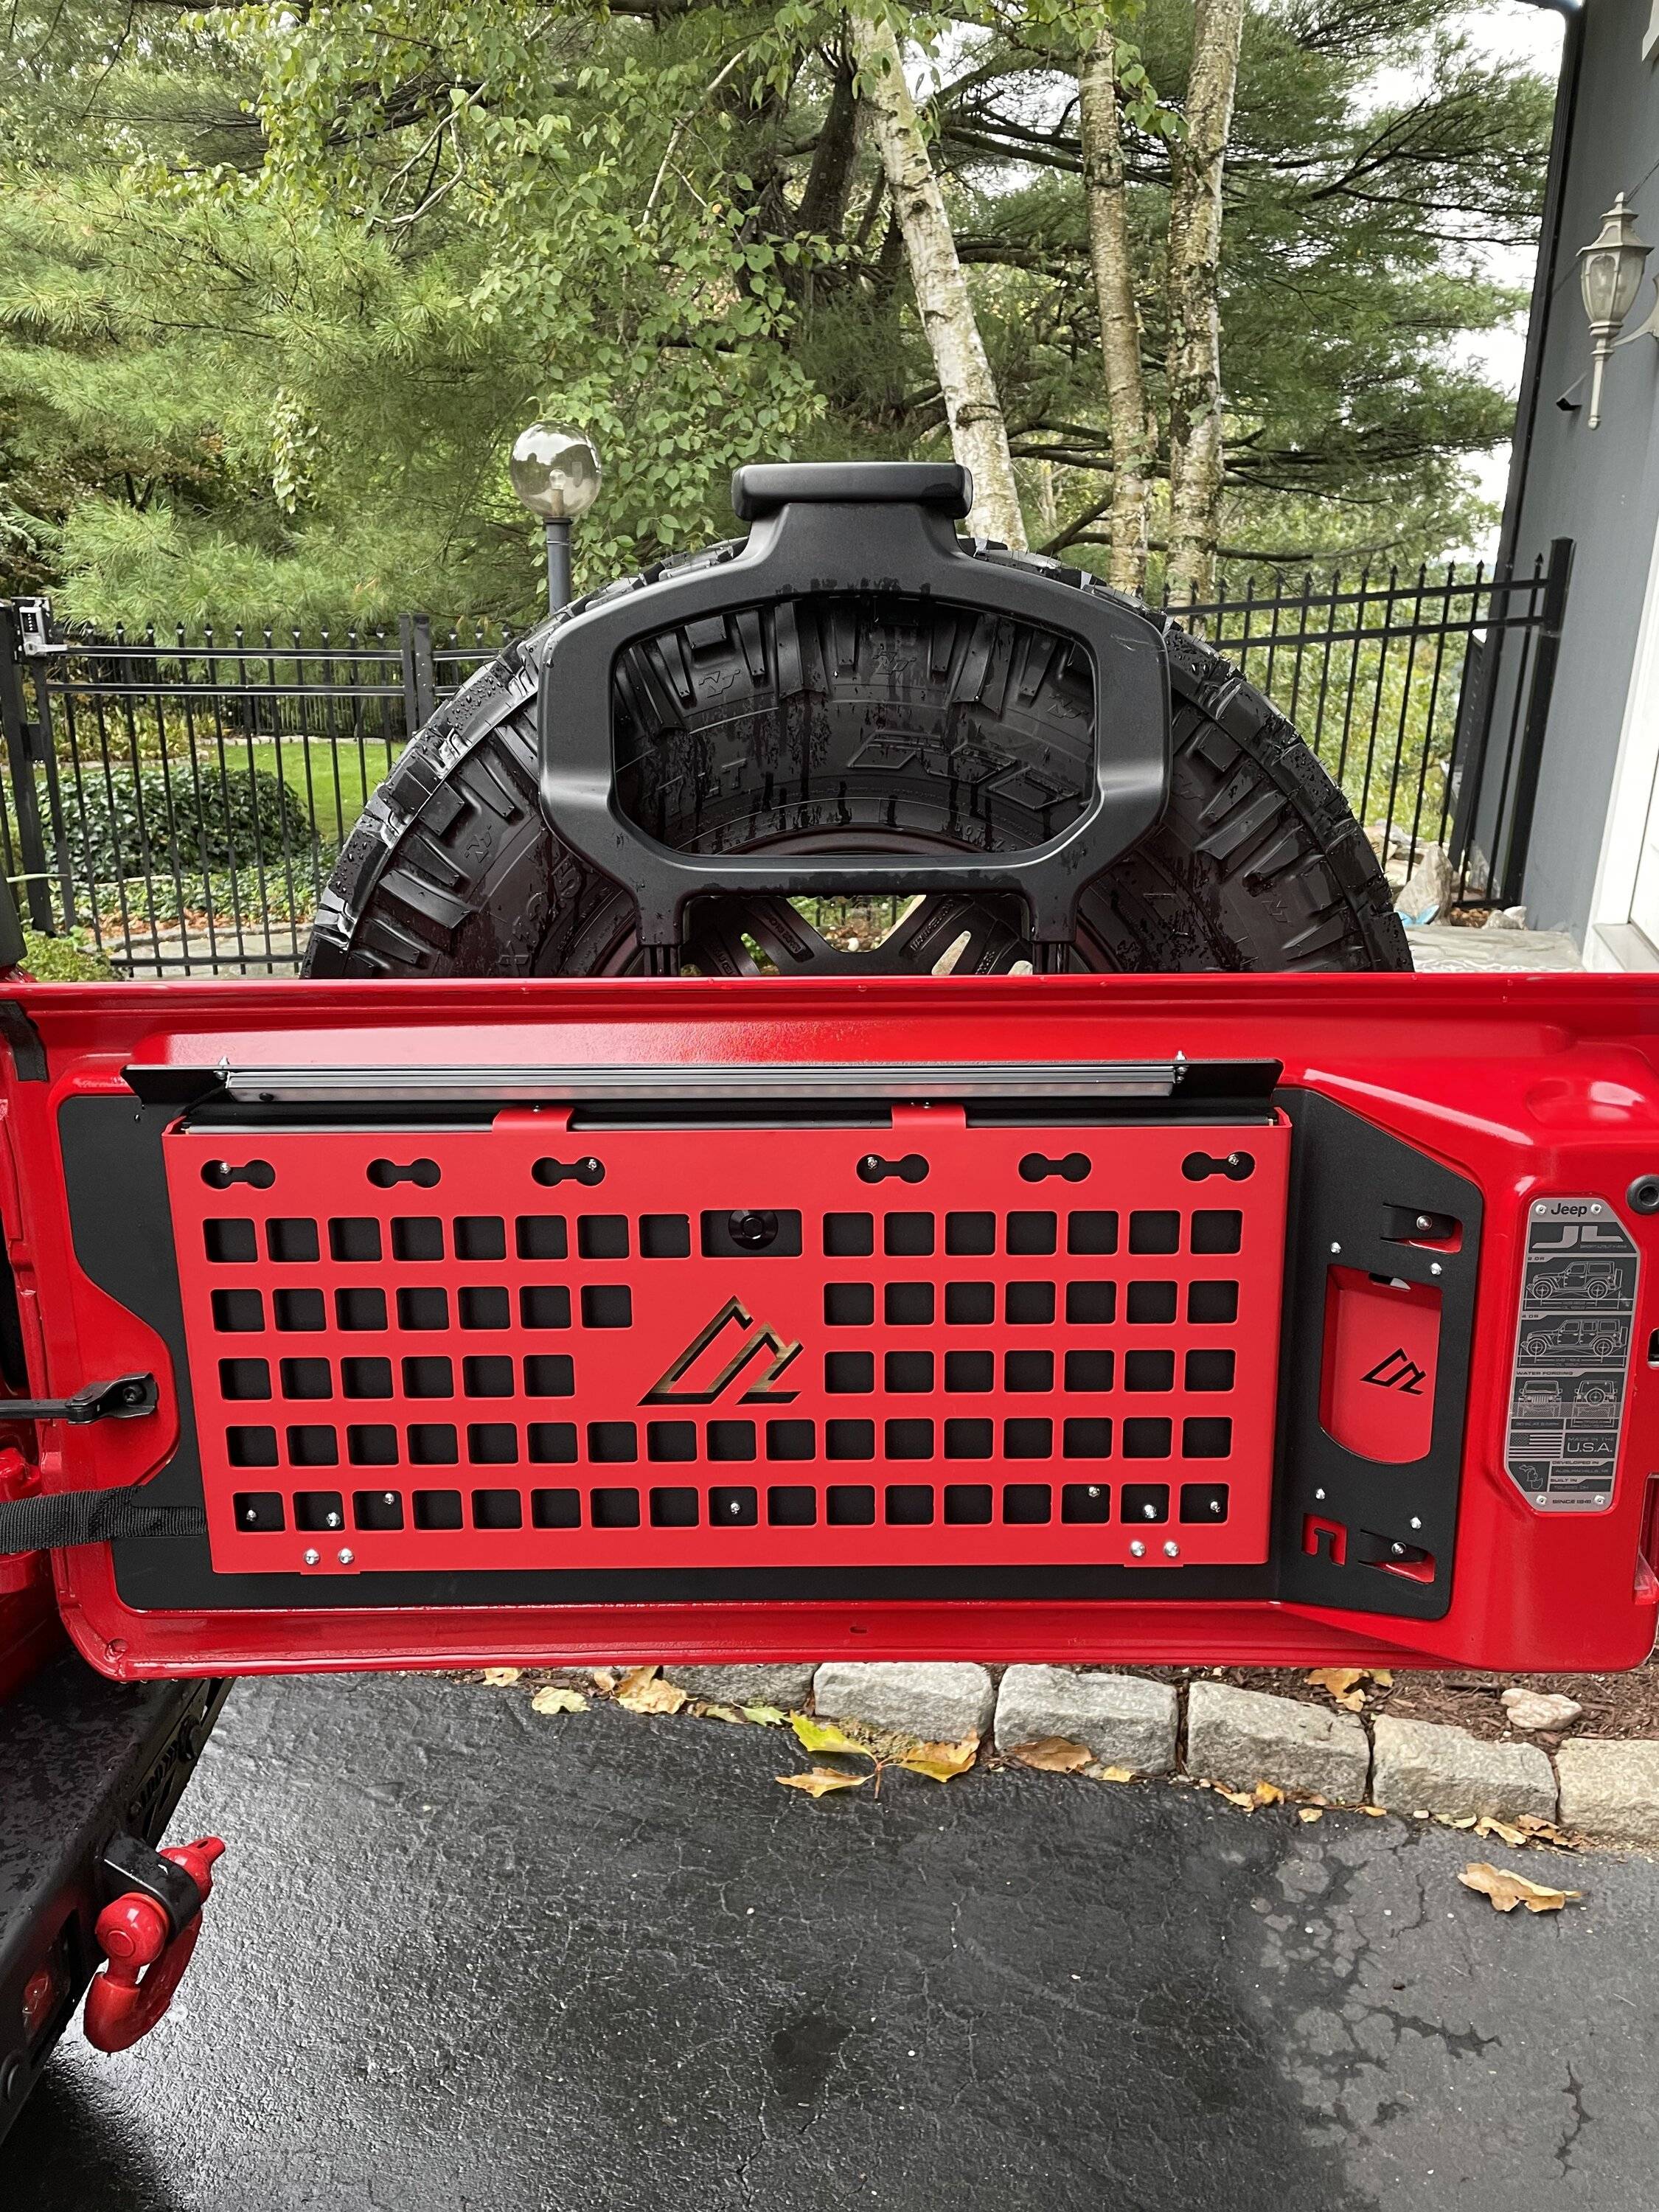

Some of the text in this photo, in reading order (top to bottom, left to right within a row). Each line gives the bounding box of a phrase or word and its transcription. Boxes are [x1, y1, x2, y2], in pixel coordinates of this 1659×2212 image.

[1551, 1203, 1587, 1217] Jeep
[1531, 1225, 1624, 1249] JL
[1567, 1442, 1613, 1453] U.S.A.
